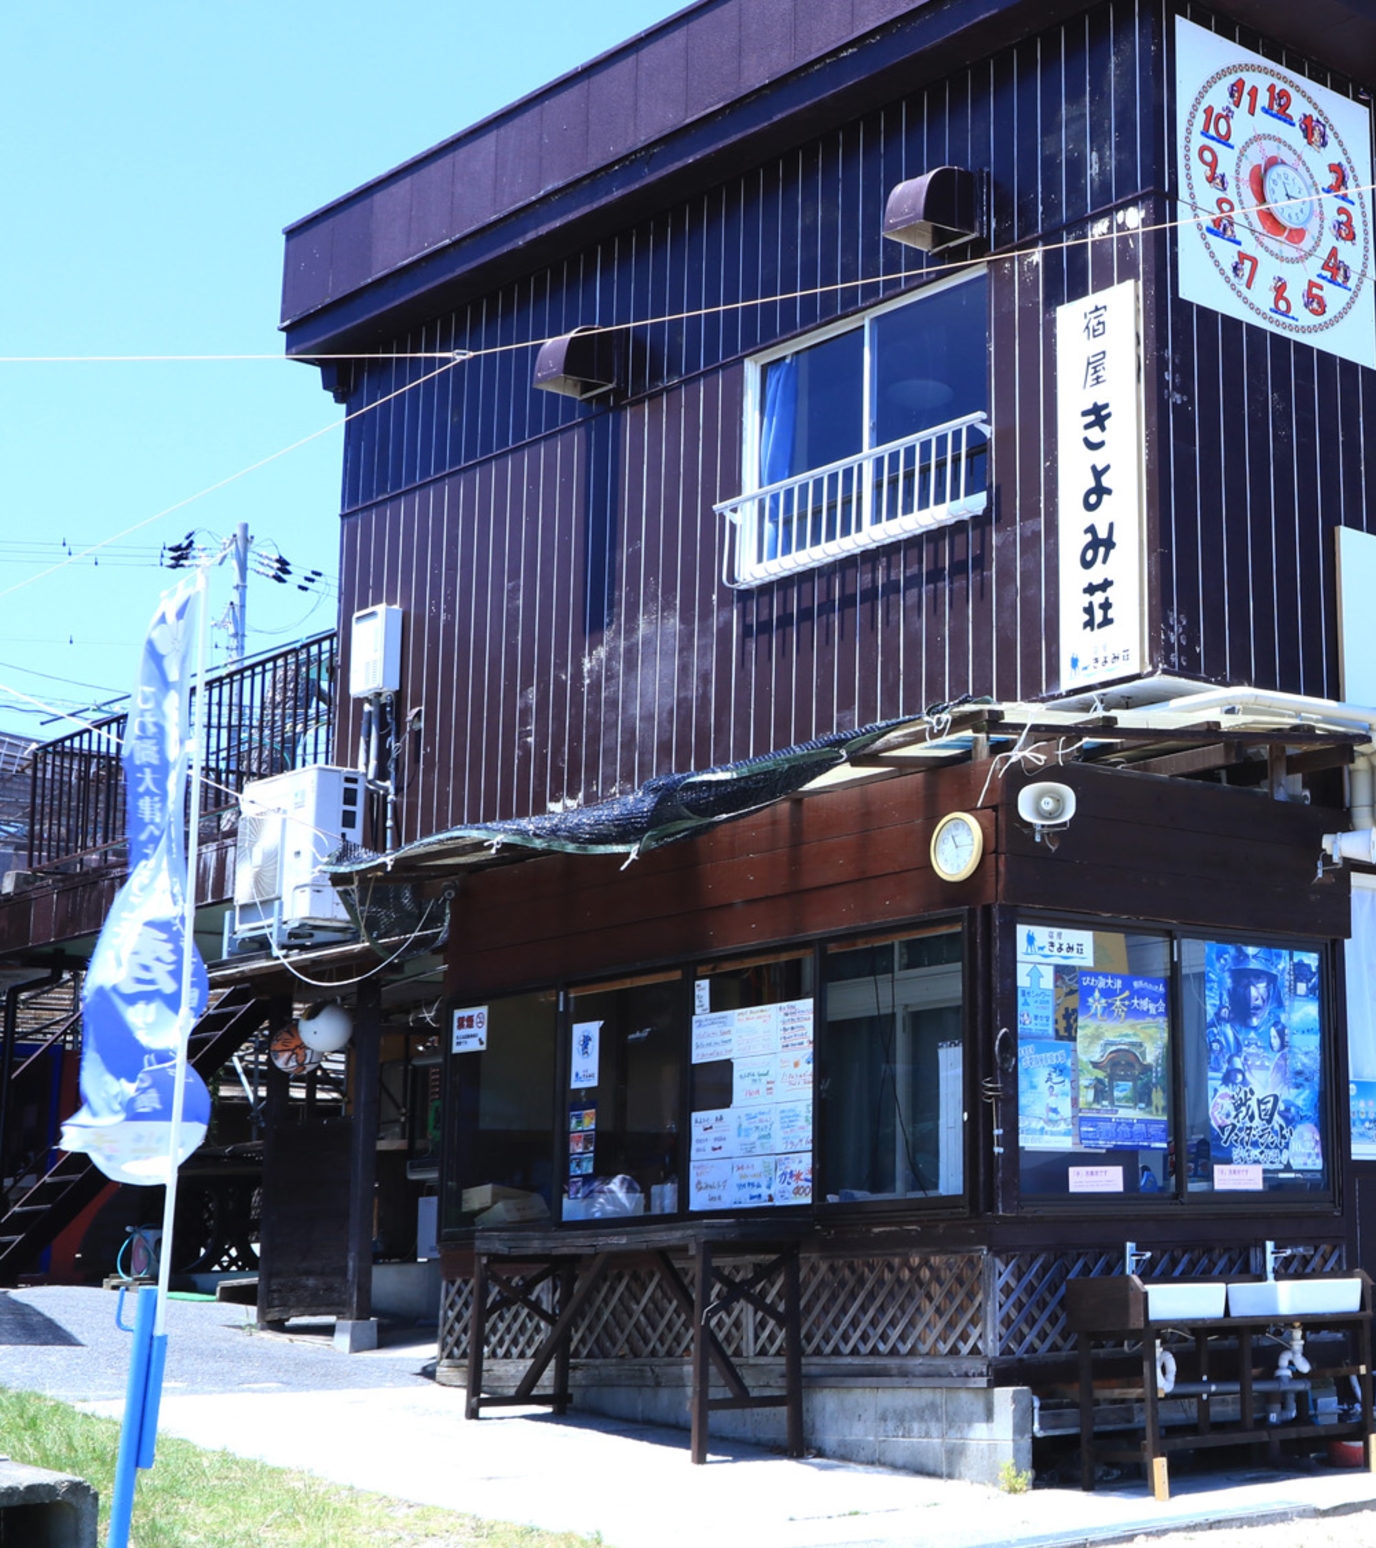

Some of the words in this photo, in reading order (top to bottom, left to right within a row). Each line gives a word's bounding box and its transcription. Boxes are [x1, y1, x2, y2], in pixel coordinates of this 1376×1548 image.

[1266, 83, 1294, 121] 12
[1203, 105, 1231, 142] 10
[1198, 144, 1219, 184] 9
[1238, 251, 1258, 289] 7
[1273, 282, 1292, 315] 6
[1307, 279, 1327, 316] 5
[1048, 941, 1084, 955] きよみ荘
